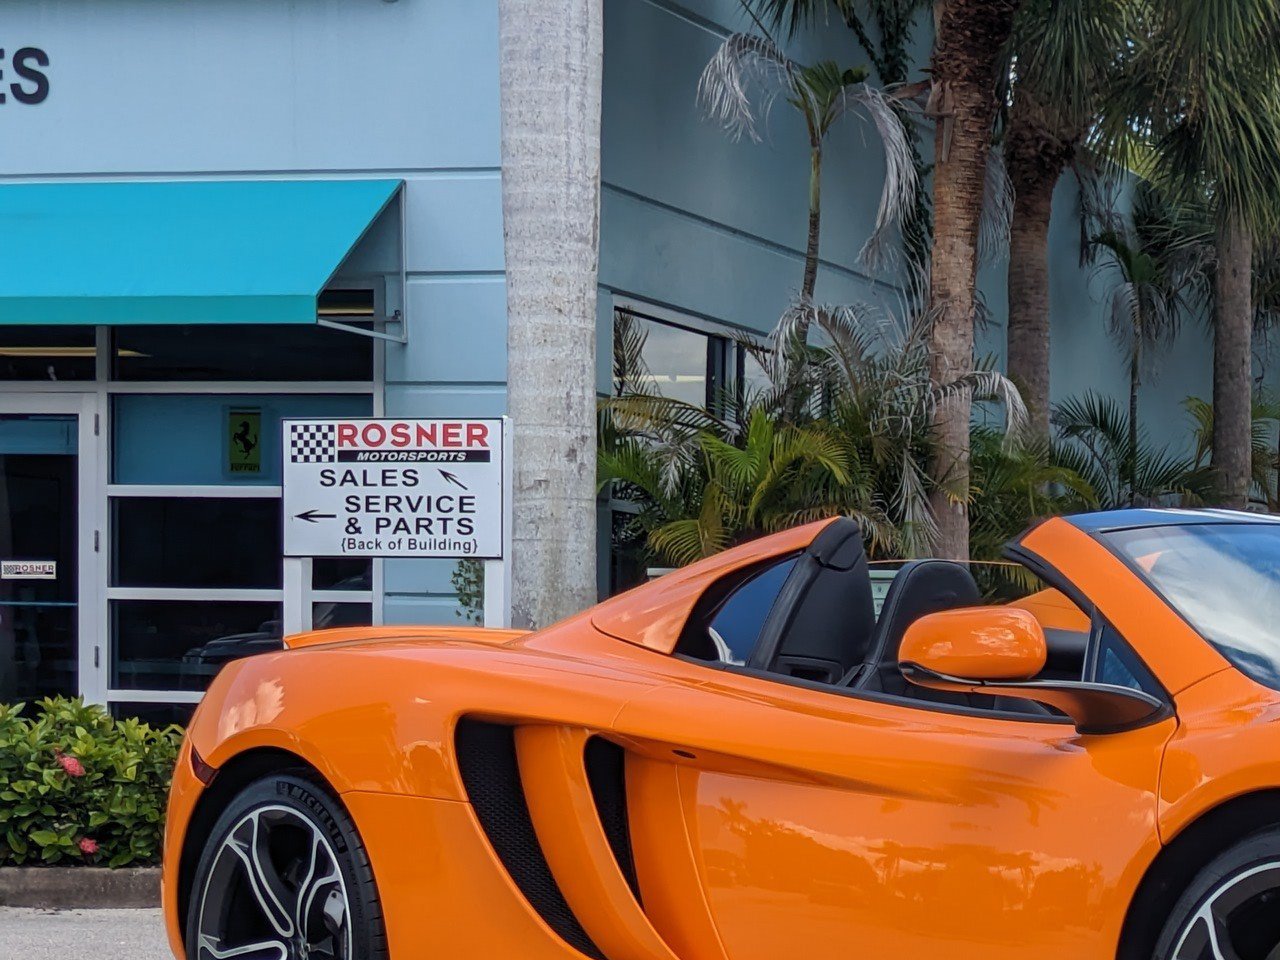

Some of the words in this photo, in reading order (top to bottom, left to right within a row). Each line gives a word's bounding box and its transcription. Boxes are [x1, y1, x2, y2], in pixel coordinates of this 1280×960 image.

[0, 47, 50, 105] S
[337, 423, 489, 448] ROSNER
[356, 451, 467, 461] MOTORSPORTS
[320, 469, 419, 487] SALES
[345, 495, 476, 514] SERVICE
[344, 517, 362, 535] &
[375, 517, 474, 536] PARTS
[341, 538, 381, 553] {Back
[388, 538, 402, 551] of
[408, 538, 478, 554] Building}
[15, 564, 54, 572] ROSNER
[290, 785, 347, 850] MICHELIN
